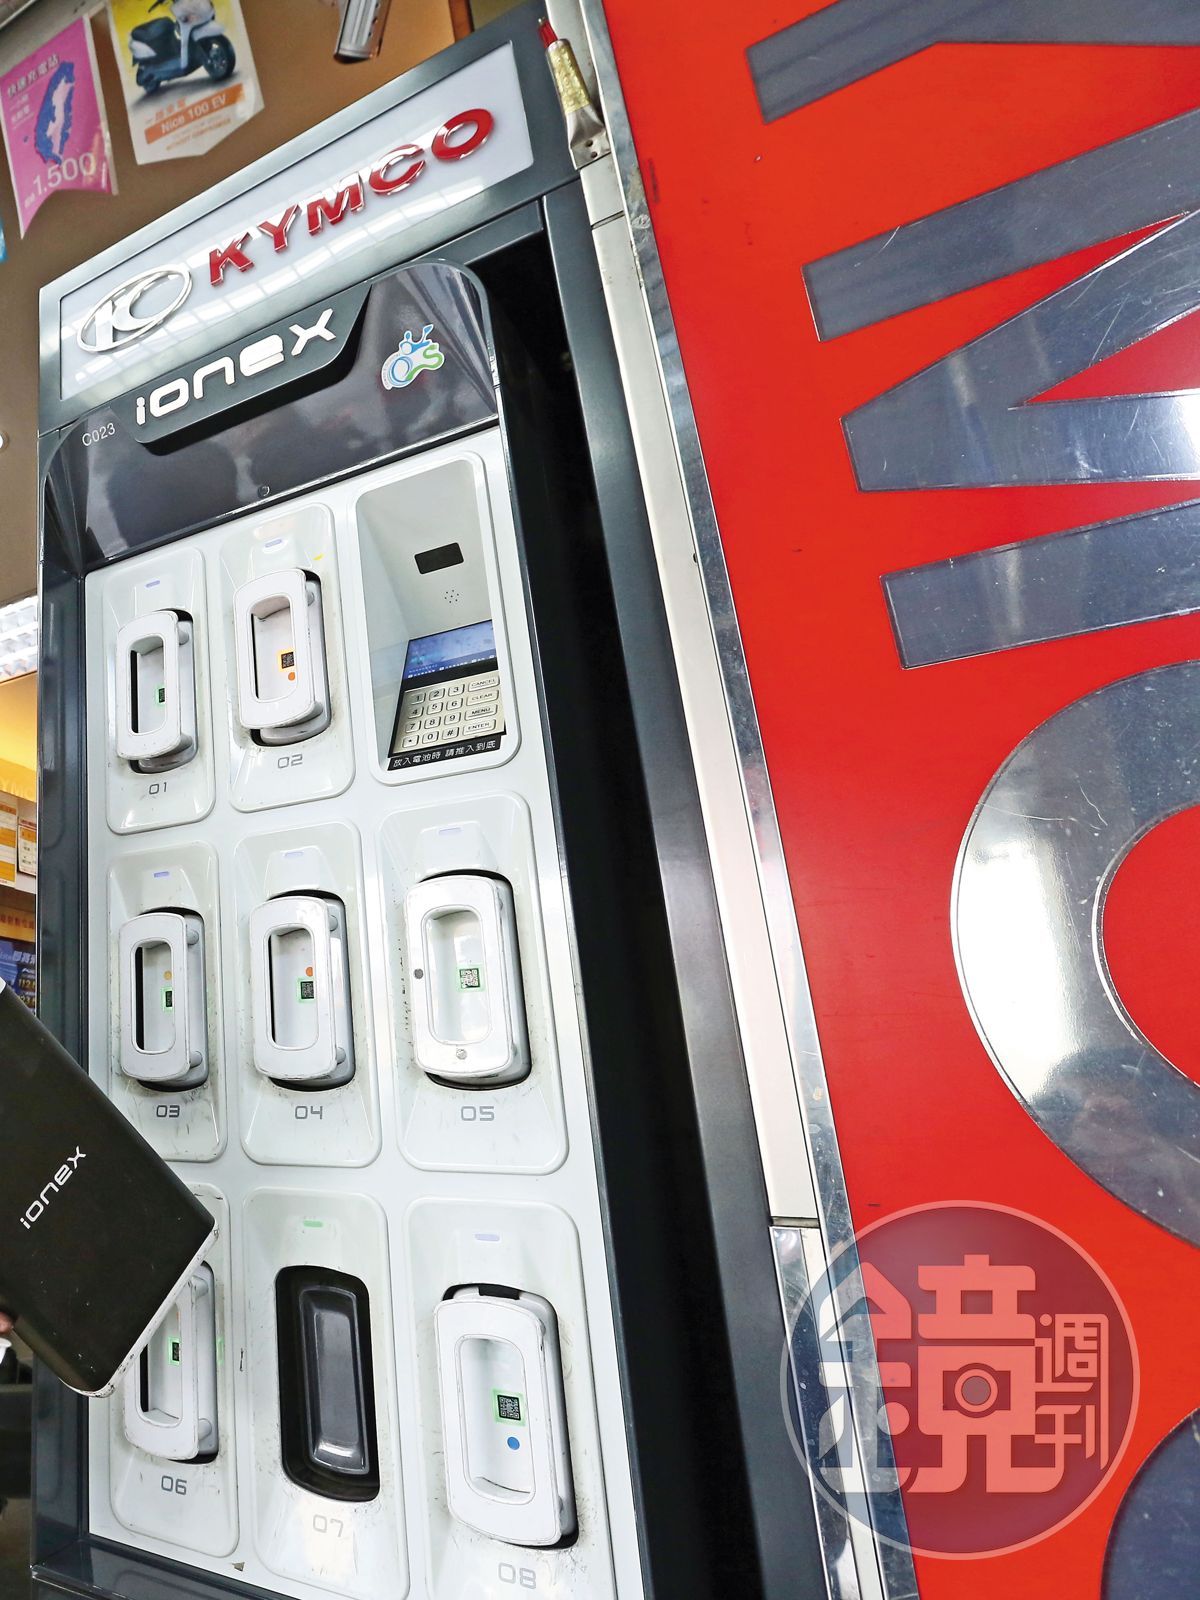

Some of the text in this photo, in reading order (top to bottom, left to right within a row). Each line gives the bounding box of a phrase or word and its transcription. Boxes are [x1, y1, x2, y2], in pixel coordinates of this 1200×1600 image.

[161, 115, 185, 135] Nice
[188, 100, 209, 120] 100
[212, 93, 227, 109] EV
[208, 108, 495, 287] KYMCO
[136, 308, 336, 426] ionex
[82, 423, 116, 447] C023
[471, 679, 496, 687] CANCEL
[471, 692, 493, 701] CLEAR
[471, 707, 491, 715] MENU
[467, 722, 490, 730] ENTER
[278, 753, 303, 769] 02
[148, 782, 167, 795] 01
[156, 1104, 180, 1119] 03
[294, 1105, 323, 1120] 04
[460, 1106, 495, 1122] 05
[20, 1145, 87, 1230] ionex
[161, 1475, 187, 1496] 06
[312, 1514, 344, 1539] 07
[497, 1563, 537, 1590] 08
